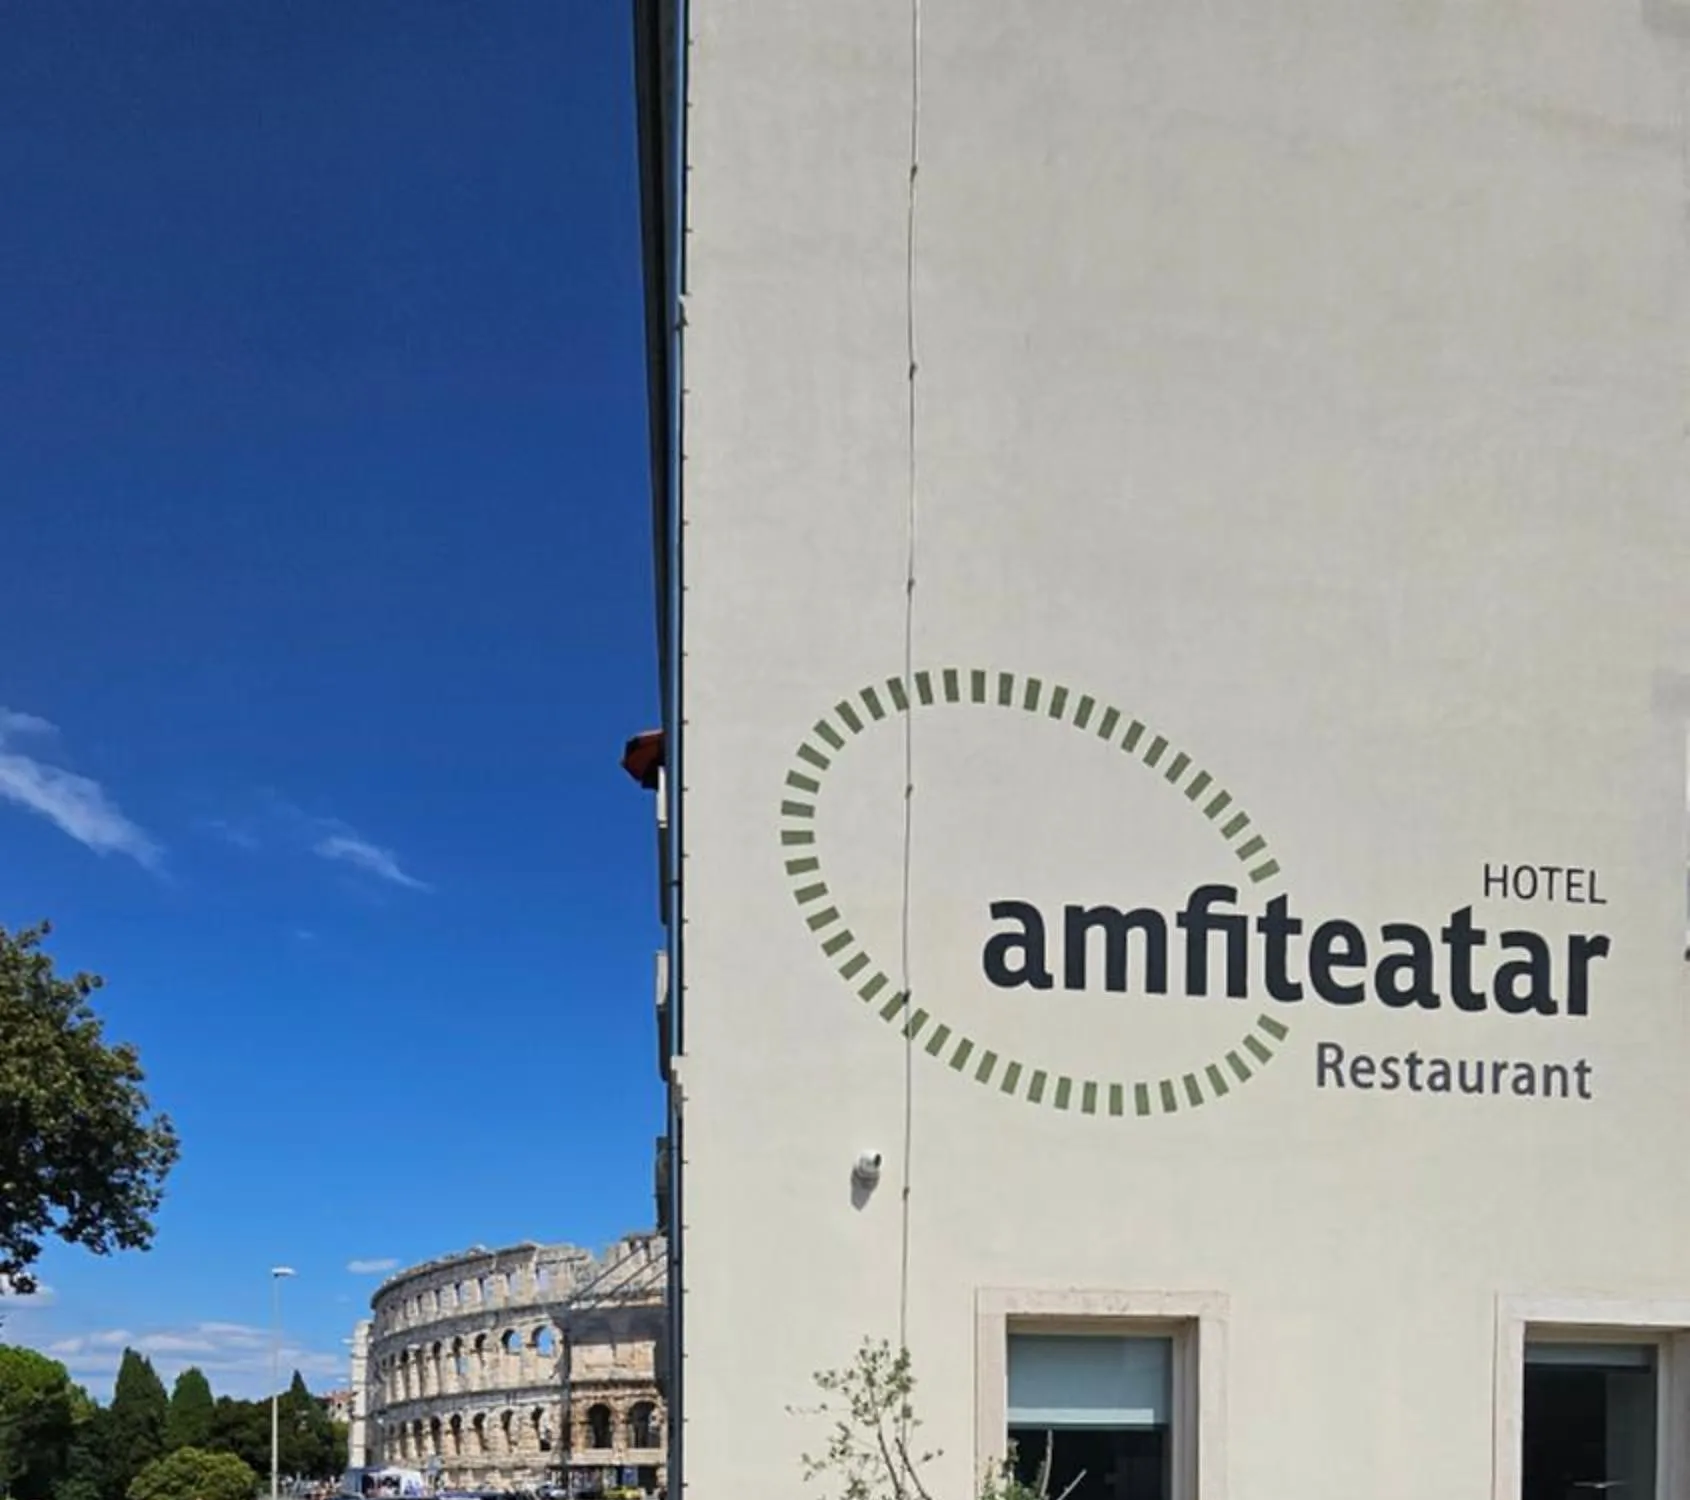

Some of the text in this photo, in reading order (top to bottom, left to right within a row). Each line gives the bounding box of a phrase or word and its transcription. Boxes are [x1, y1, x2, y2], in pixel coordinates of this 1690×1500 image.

[1484, 863, 1608, 904] HOTEL
[984, 884, 1610, 1016] amfiteatar
[1318, 1043, 1592, 1099] Restaurant
